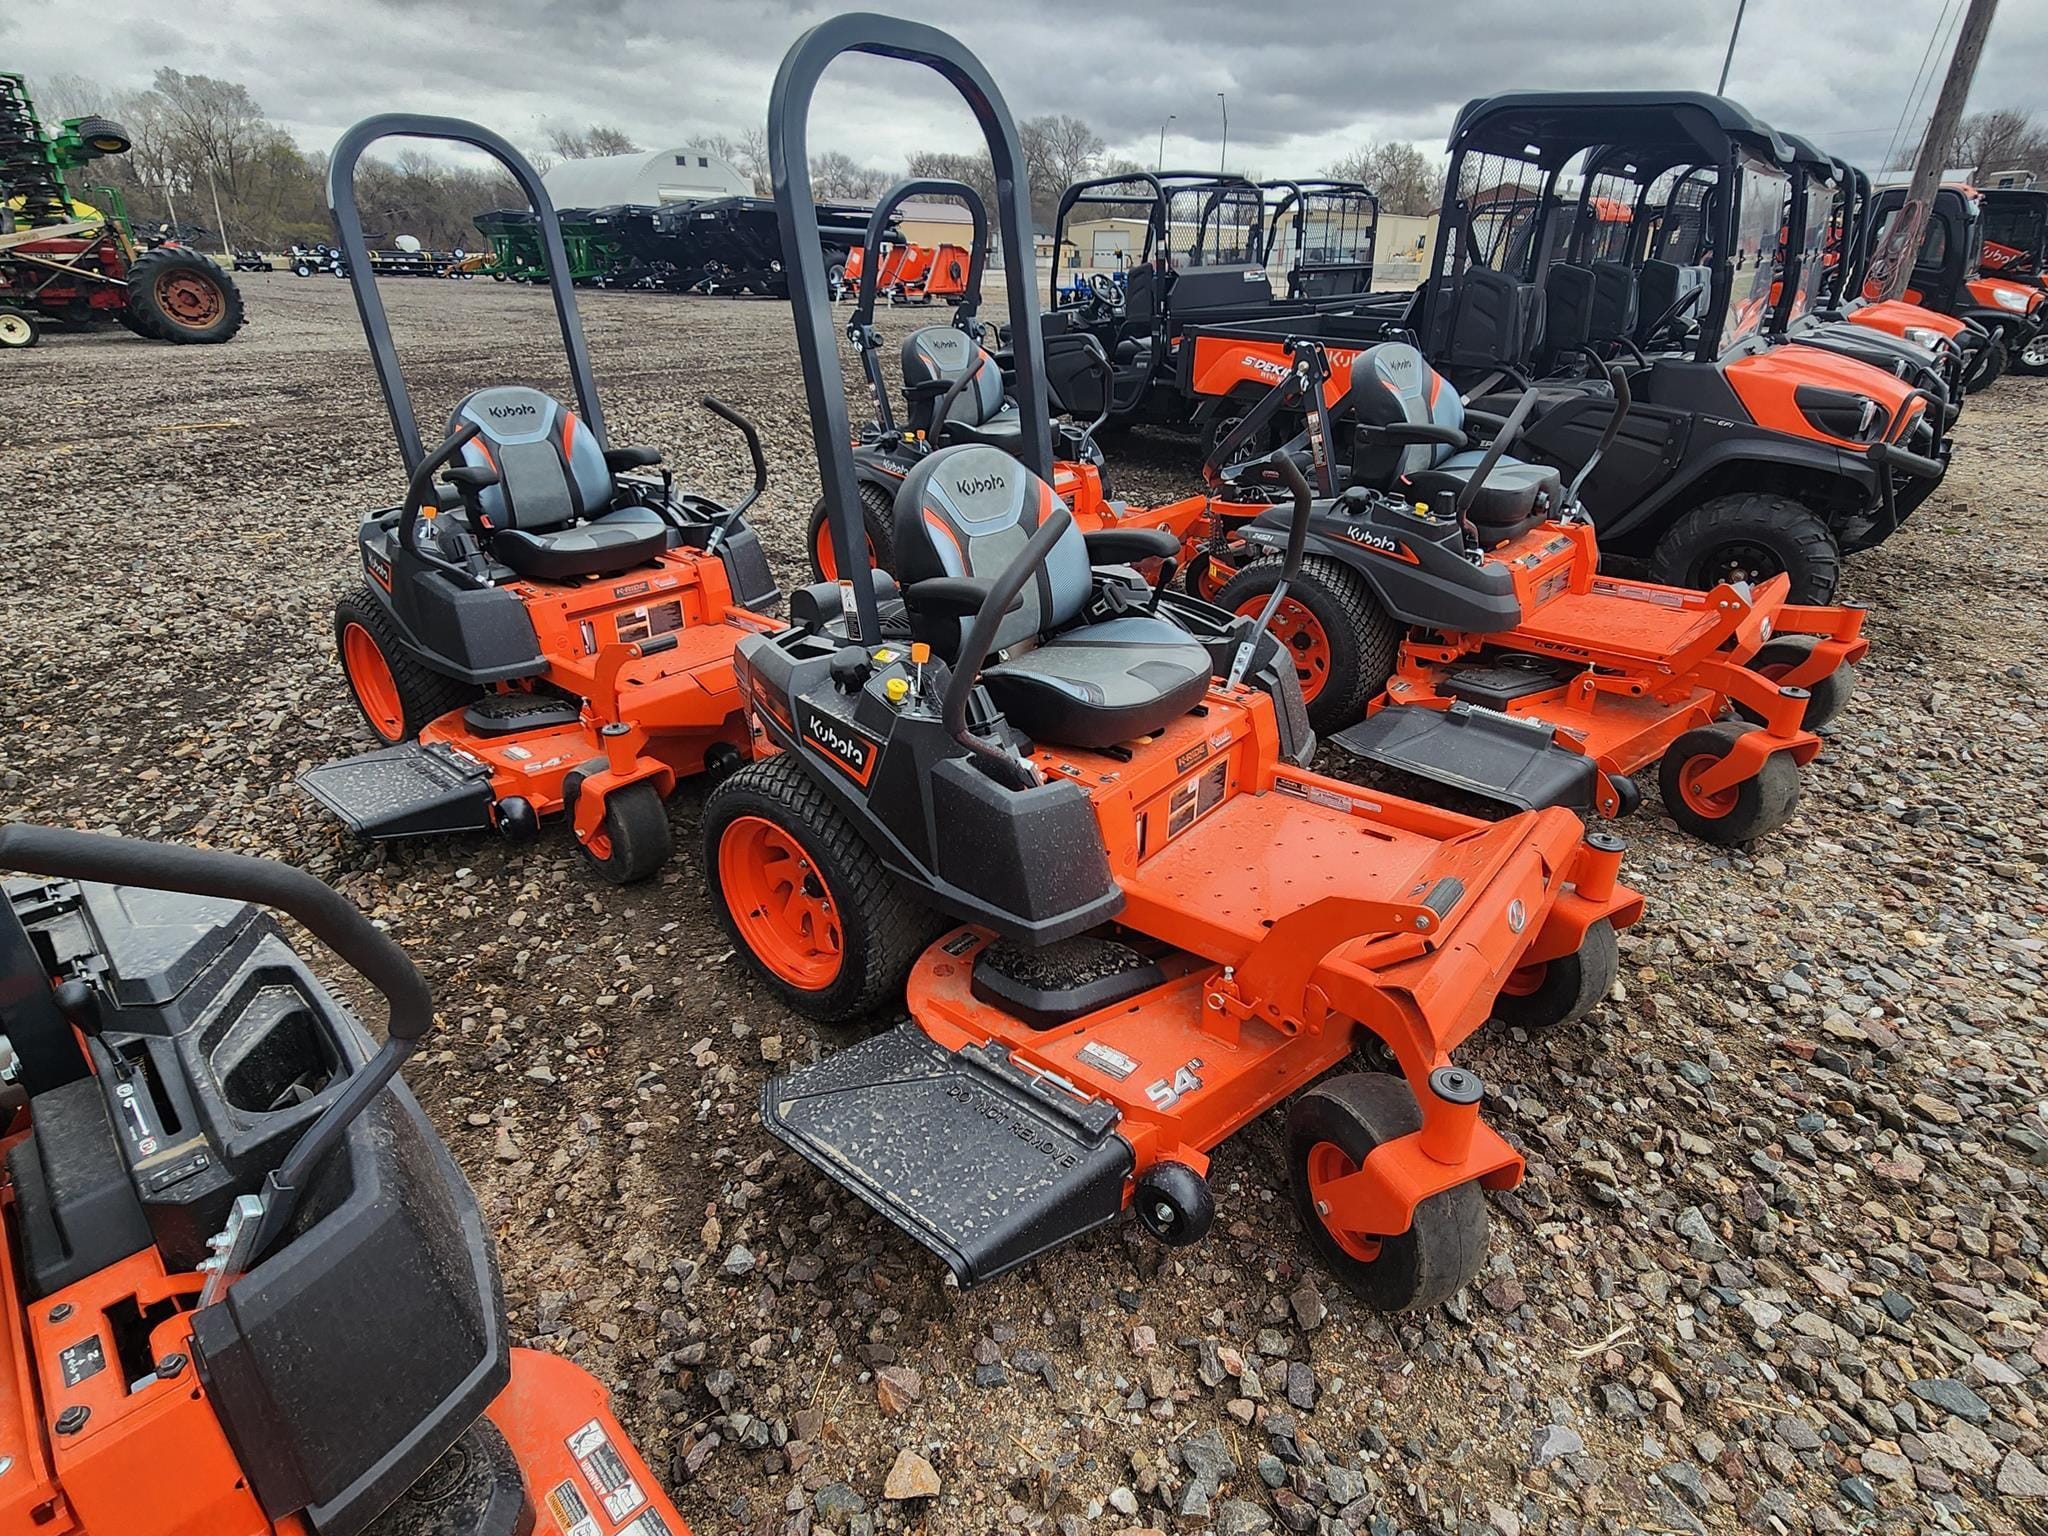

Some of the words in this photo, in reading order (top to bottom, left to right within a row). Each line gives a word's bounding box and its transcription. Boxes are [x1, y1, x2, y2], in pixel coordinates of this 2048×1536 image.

[488, 403, 536, 418] Kubota
[1479, 439, 1495, 447] EP
[956, 473, 1006, 496] Kubota
[1347, 525, 1396, 552] Kubota
[809, 714, 864, 766] Kubota
[1144, 1057, 1204, 1112] 54"
[946, 1085, 974, 1104] DO
[974, 1100, 1009, 1125] NOT
[1007, 1121, 1079, 1169] REMOVE
